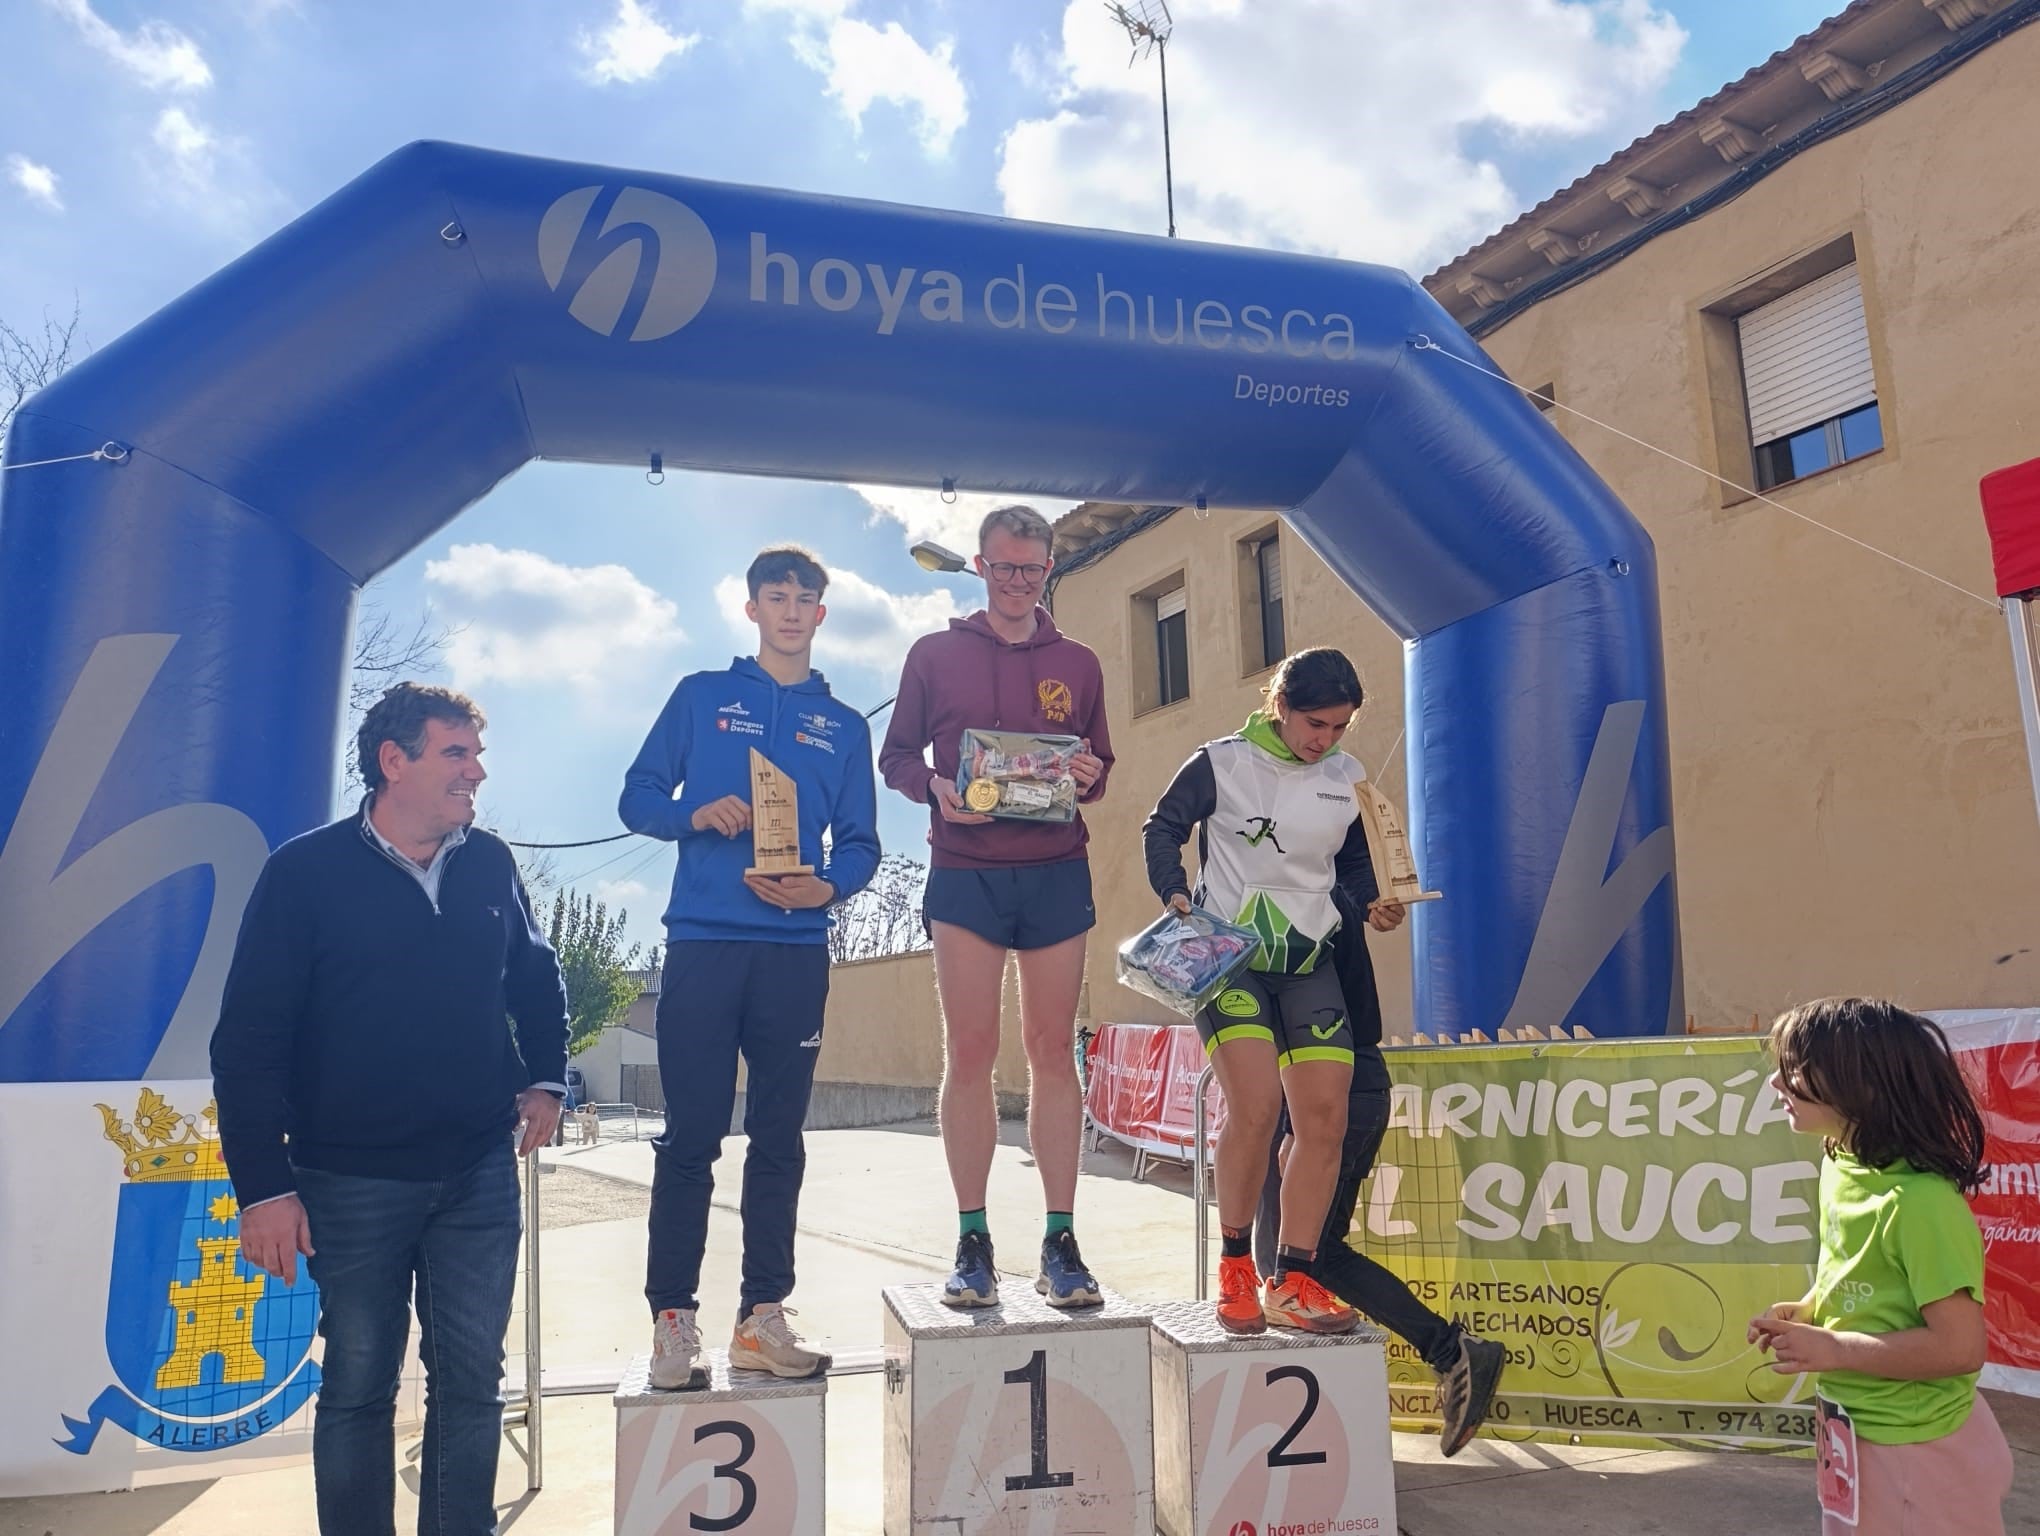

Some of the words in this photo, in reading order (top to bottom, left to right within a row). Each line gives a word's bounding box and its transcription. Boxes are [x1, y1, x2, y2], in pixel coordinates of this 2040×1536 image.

[751, 232, 964, 335] hoya
[984, 264, 1078, 334] de
[1098, 273, 1356, 361] huesca
[1235, 374, 1351, 407] Deportes
[731, 718, 764, 729] Zaragoza
[1387, 1069, 1790, 1138] ARNICERÍA
[1349, 1162, 1417, 1236] L
[1456, 1160, 1819, 1245] SAUCE
[1450, 1282, 1610, 1310] ARTESANOS,
[1453, 1311, 1591, 1336] MECHADOS
[148, 1409, 274, 1446] ALERRE
[1004, 1350, 1074, 1491] 1
[1265, 1365, 1327, 1467] 2
[1545, 1403, 1642, 1428] HUESCA
[1678, 1410, 1705, 1430] T.
[1717, 1411, 1765, 1432] 974
[689, 1421, 757, 1532] 3
[1308, 1520, 1325, 1534] de
[1328, 1517, 1378, 1532] huesca
